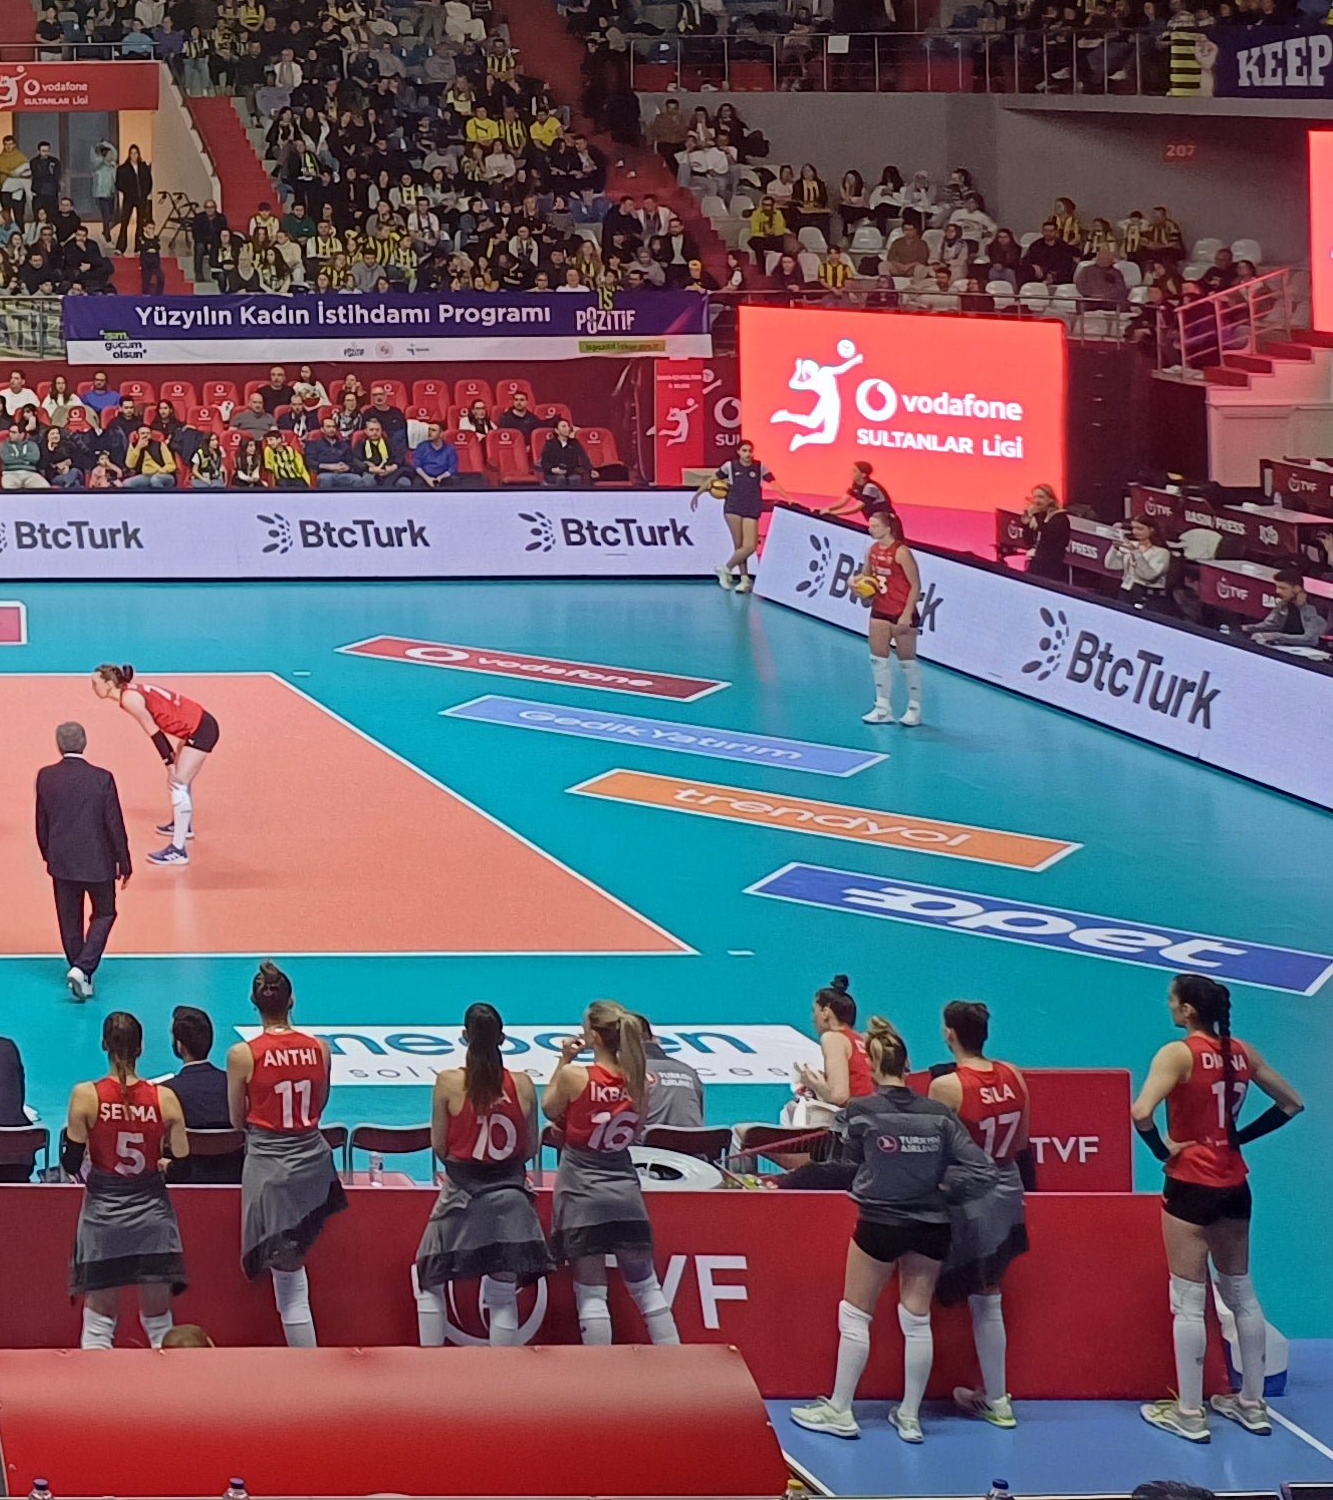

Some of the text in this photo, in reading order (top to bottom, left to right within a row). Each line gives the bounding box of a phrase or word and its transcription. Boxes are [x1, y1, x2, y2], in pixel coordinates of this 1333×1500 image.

[1236, 34, 1333, 87] KEEP
[42, 82, 88, 91] vodafone
[1166, 144, 1195, 157] 207
[135, 301, 551, 329] Yüzyılın Kadın İstihdamı Programı
[901, 392, 1023, 421] vodafone
[856, 428, 1023, 459] SULTANLAR LİGİ
[14, 520, 145, 552] BtcTurk
[299, 518, 431, 550] BtcTurk
[563, 517, 695, 549] BtcTurk
[475, 654, 653, 688] vodafone
[1066, 629, 1222, 730] BtcTurk
[673, 787, 973, 848] trendyol
[263, 1047, 317, 1067] ANTHI
[274, 1079, 312, 1128] 11
[590, 1080, 632, 1102] İKBA
[979, 1083, 1016, 1104] SILA
[472, 1113, 517, 1161] 10
[588, 1111, 639, 1153] 16
[979, 1110, 1022, 1158] 17
[114, 1131, 147, 1176] 5
[1029, 1136, 1100, 1164] TVF
